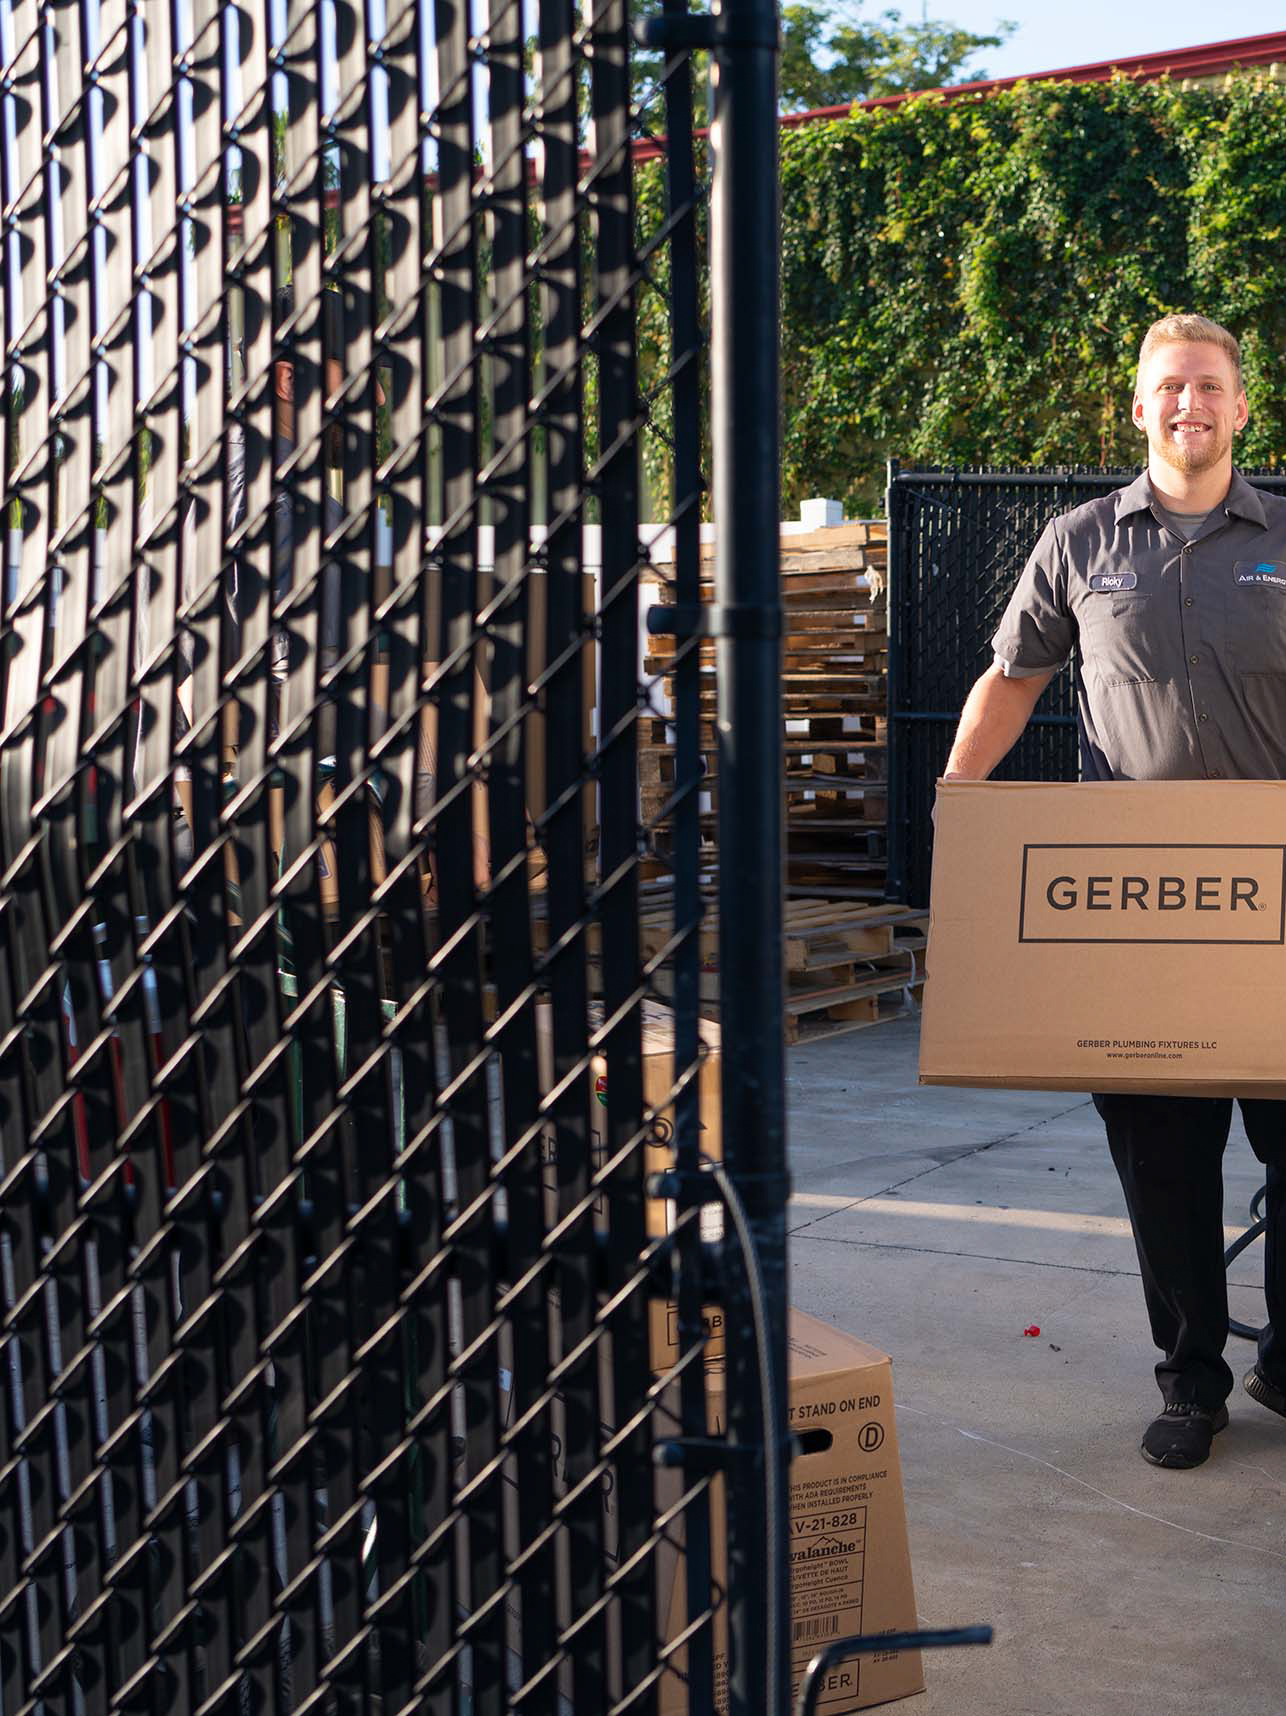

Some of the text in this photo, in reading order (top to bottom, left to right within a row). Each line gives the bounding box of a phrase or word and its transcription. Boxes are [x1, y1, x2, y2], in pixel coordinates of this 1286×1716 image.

[1046, 876, 1260, 911] GERBER
[1076, 1040, 1217, 1049] GERBER PLUMBING FIXTURES LLC
[1106, 1052, 1183, 1060] www.gerberonline.com
[798, 1402, 836, 1419] STAND
[839, 1399, 856, 1412] ON
[858, 1395, 881, 1410] END
[790, 1483, 801, 1492] HIS
[802, 1479, 832, 1490] PRODUCT
[848, 1470, 888, 1483] COMPLIANCE
[790, 1492, 803, 1502] ITH
[820, 1483, 867, 1497] REQUIREMENTS
[790, 1491, 873, 1511] HEN INSTALLED PROPERLY
[790, 1541, 856, 1562] valanche
